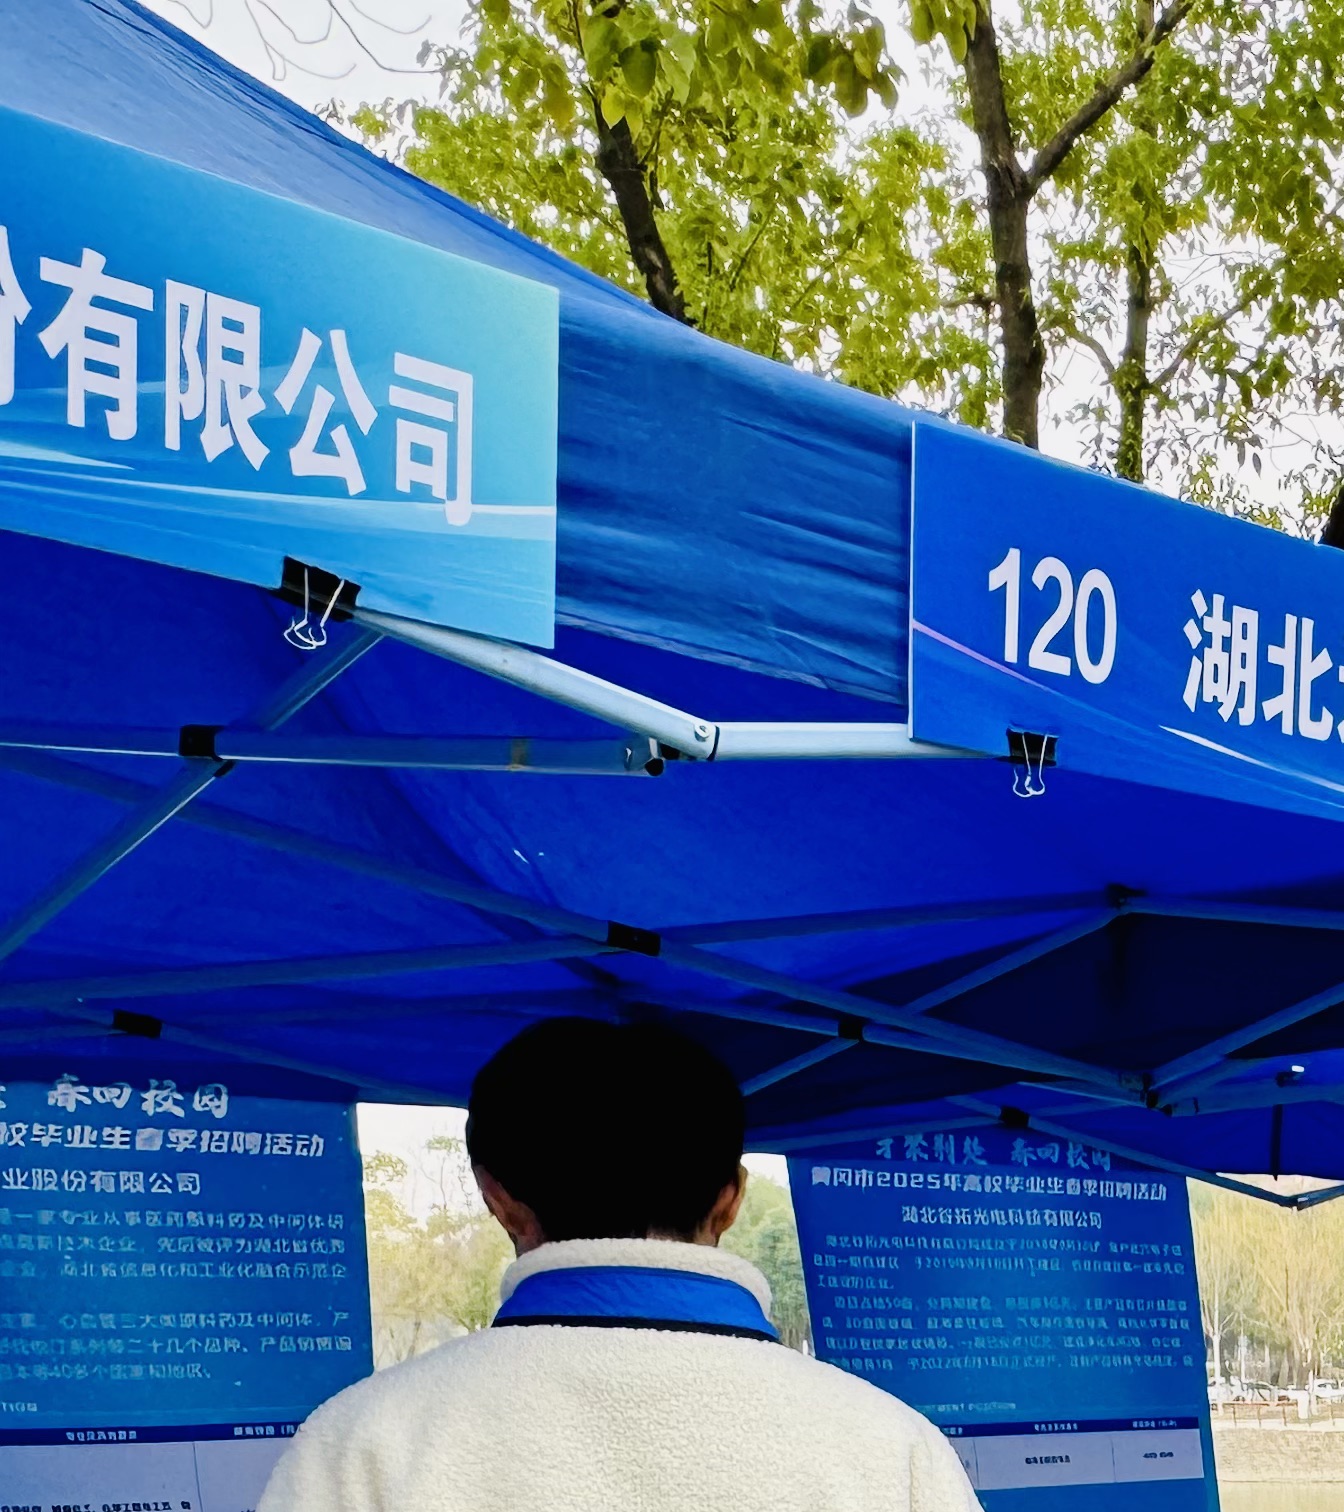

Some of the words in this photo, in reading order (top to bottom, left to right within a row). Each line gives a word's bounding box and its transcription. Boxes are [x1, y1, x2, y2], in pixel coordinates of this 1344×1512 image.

[988, 547, 1117, 684] 120
[2, 1167, 200, 1196] 业股份有限公司
